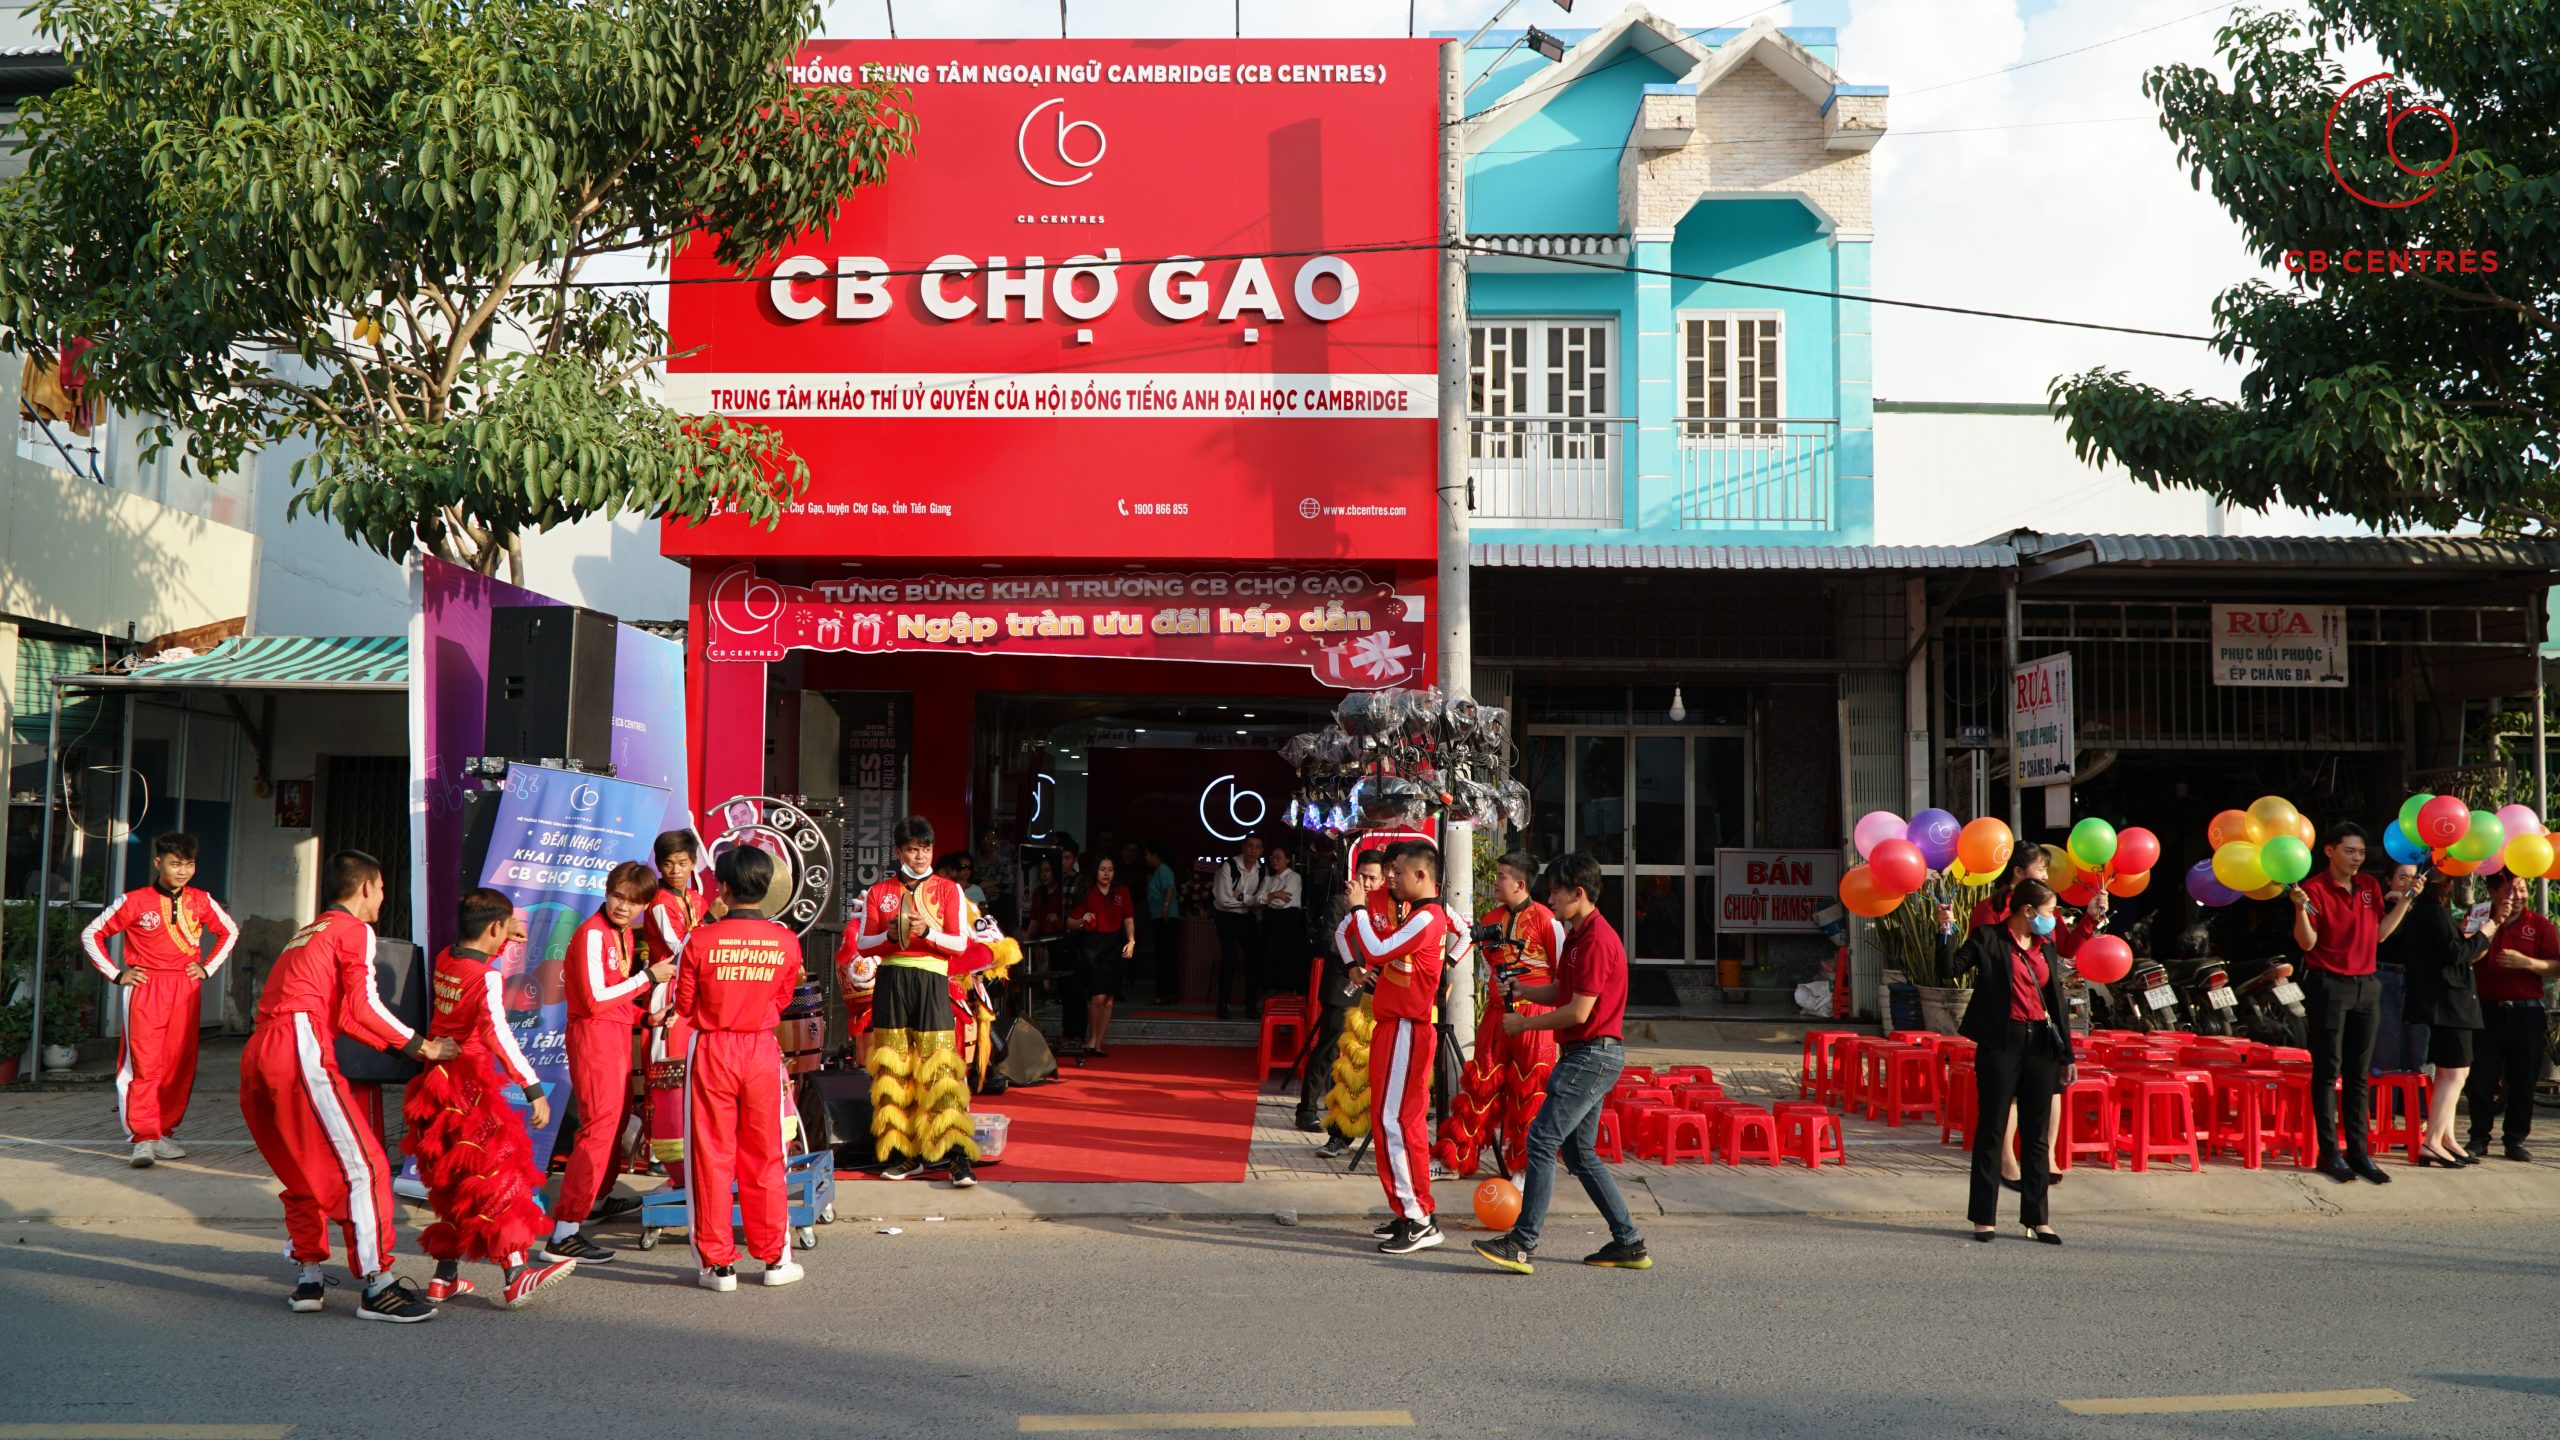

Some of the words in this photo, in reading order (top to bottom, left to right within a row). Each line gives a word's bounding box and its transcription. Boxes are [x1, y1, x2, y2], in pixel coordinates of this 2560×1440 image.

[937, 60, 977, 83] TÂM
[983, 64, 1049, 88] NGOẠI
[1056, 60, 1102, 83] NGỮ
[1108, 64, 1231, 83] CAMBRIDGE
[1237, 63, 1272, 85] (CB
[1278, 63, 1387, 85] CENTRES)
[1017, 215, 1035, 224] CB
[1041, 215, 1105, 224] CENTRES
[770, 255, 893, 320] CB
[920, 248, 1118, 344] CHỢ
[1149, 255, 1360, 344] GẠO
[711, 389, 770, 410] TRUNG
[777, 384, 811, 410] TÂM
[817, 381, 865, 410] KHẢO
[871, 384, 897, 410] THÍ
[931, 380, 989, 411] QUYỀN
[995, 381, 1030, 411] CỦA
[1035, 384, 1067, 415] HỘI
[1072, 379, 1121, 411] ĐỒNG
[1126, 379, 1177, 411] TIẾNG
[1182, 389, 1219, 410] ANH
[1225, 389, 1254, 415] ĐẠI
[1260, 389, 1297, 415] HỌC
[1304, 389, 1408, 411] CAMBRIDGE
[790, 502, 804, 515] Chợ
[807, 502, 824, 515] Gạo,
[827, 502, 849, 515] huyện
[853, 502, 868, 515] Chợ
[872, 502, 889, 515] Gạo,
[892, 500, 907, 513] tỉnh
[930, 503, 952, 516] Giang
[1134, 503, 1153, 515] 1900
[1155, 503, 1171, 515] 866
[1173, 503, 1188, 515] 855
[1323, 504, 1407, 516] www.cbcentres.com
[819, 583, 898, 603] TƯNG
[906, 577, 985, 602] BỪNG
[992, 580, 1060, 600] KHAI
[1066, 577, 1185, 598] TRƯƠNG
[1191, 577, 1229, 597] CB
[1235, 575, 1297, 599] CHỢ
[1302, 575, 1364, 599] GẠO
[898, 611, 998, 643] Ngập
[1006, 609, 1085, 637] tràn
[1093, 611, 1143, 635] ưu
[1151, 608, 1210, 634] đãi
[1219, 603, 1291, 637] hấp
[1299, 600, 1371, 633] dẫn
[2221, 648, 2253, 664] PHỤC
[2282, 646, 2322, 664] PHUỘC
[2295, 669, 2312, 681] BA
[1965, 727, 1985, 737] 110
[858, 752, 882, 886] CENTRES
[540, 831, 567, 848] ĐÊM
[569, 834, 602, 852] NHẠC
[513, 848, 552, 864] KHAI
[557, 852, 620, 872] TRƯƠNG
[1747, 855, 1813, 886] BÁN
[508, 866, 532, 881] CB
[535, 868, 572, 888] CHỢ
[1724, 887, 1769, 926] CHUỘT
[709, 947, 786, 966] LIENPHONG
